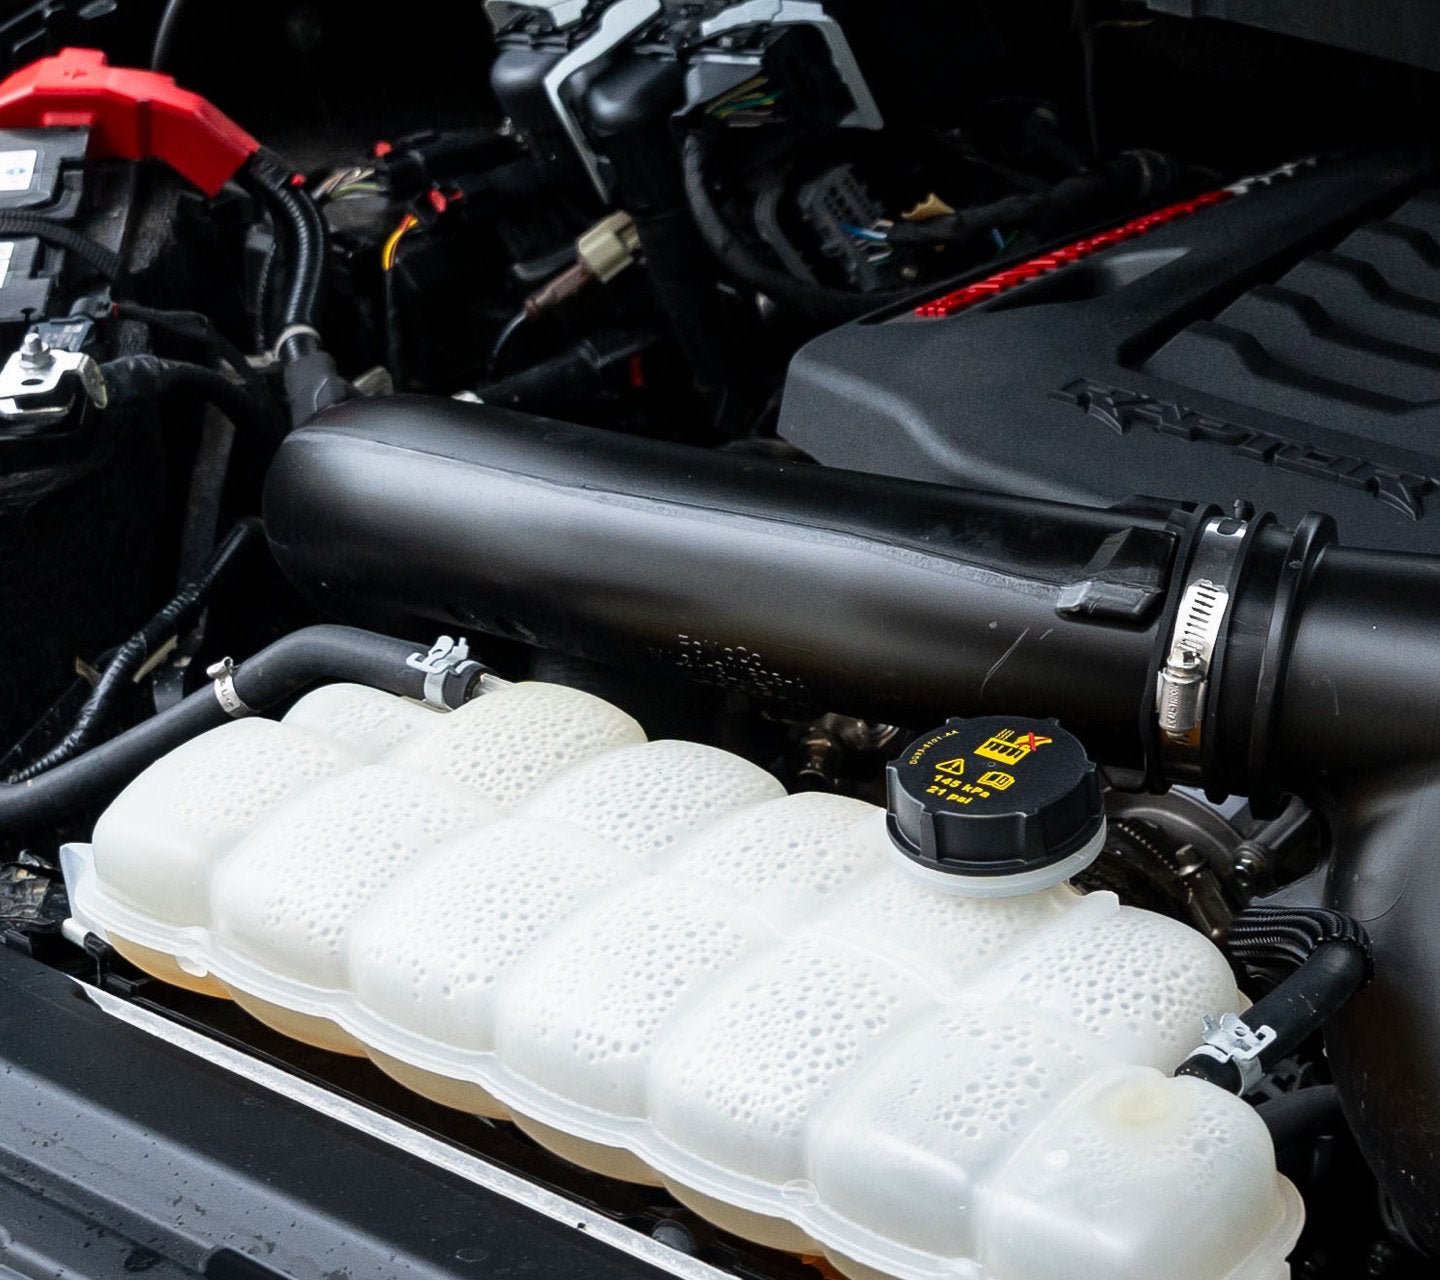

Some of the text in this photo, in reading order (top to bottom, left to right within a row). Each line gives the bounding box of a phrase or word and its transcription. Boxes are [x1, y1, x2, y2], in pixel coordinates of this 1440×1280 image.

[1049, 375, 1440, 520] RAPTOR
[926, 785, 973, 805] 21 psi
[934, 774, 991, 799] 145 kPa
